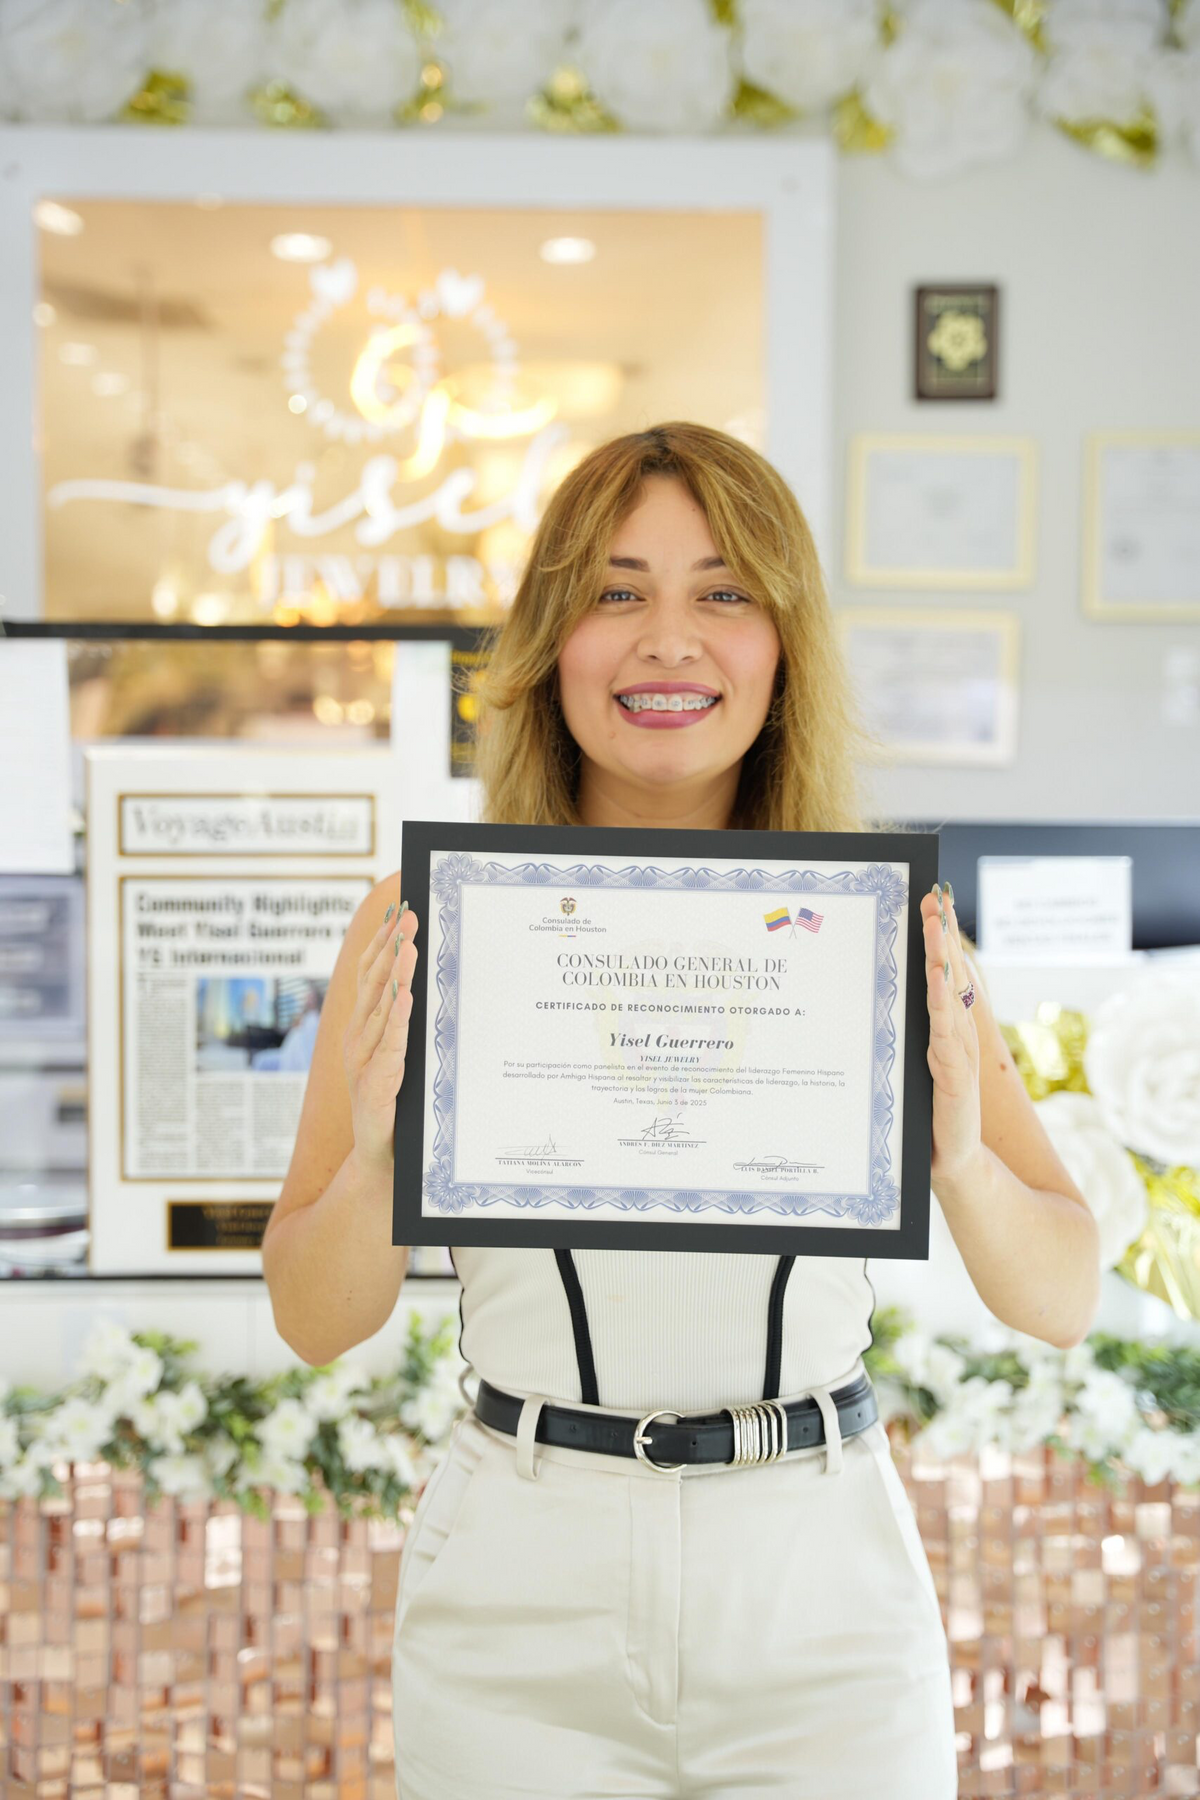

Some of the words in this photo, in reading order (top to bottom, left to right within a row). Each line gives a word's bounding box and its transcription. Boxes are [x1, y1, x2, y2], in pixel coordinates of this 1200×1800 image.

[137, 891, 244, 916] Community
[529, 924, 562, 932] Colombia
[575, 925, 607, 933] Houston
[542, 917, 580, 925] Consulado
[556, 953, 668, 970] CONSULADO
[673, 956, 758, 973] GENERAL
[765, 958, 787, 973] DE
[562, 971, 658, 988] COLOMBIA
[665, 974, 687, 988] EN
[694, 974, 780, 990] HOUSTON
[535, 1001, 607, 1011] CERTIFICADO
[610, 1003, 623, 1012] DE
[627, 1004, 725, 1014] RECONOCIMIENTO
[729, 1006, 791, 1016] OTORGADO
[794, 1008, 806, 1016] A:
[610, 1032, 651, 1048] Yisel
[655, 1034, 734, 1050] Guerrero
[640, 1055, 662, 1063] YISEL
[663, 1055, 701, 1064] JEWELRY
[503, 1060, 515, 1068] Por
[526, 1061, 571, 1070] participación
[593, 1063, 625, 1072] panelista
[680, 1065, 734, 1073] reconocimiento
[735, 1066, 747, 1074] del
[748, 1066, 781, 1076] liderazgo
[782, 1067, 815, 1076] Femenino
[817, 1068, 845, 1077] Hispano
[502, 1071, 545, 1079] desarrollado
[547, 1073, 559, 1081] por
[588, 1073, 616, 1083] Hispana
[652, 1076, 657, 1084] y
[658, 1075, 690, 1083] visibilizar
[691, 1075, 701, 1083] las
[702, 1076, 753, 1084] características
[754, 1077, 764, 1085] de
[766, 1077, 800, 1088] liderazgo,
[801, 1078, 808, 1086] la
[810, 1078, 837, 1088] historia,
[838, 1079, 845, 1087] la
[591, 1085, 629, 1093] trayectoria
[630, 1086, 635, 1094] y
[646, 1086, 668, 1095] logros
[688, 1087, 708, 1096] mujer
[709, 1088, 753, 1096] Colombiana.
[613, 1097, 634, 1105] Austin,
[636, 1098, 655, 1106] Texas,
[656, 1098, 673, 1107] Junio
